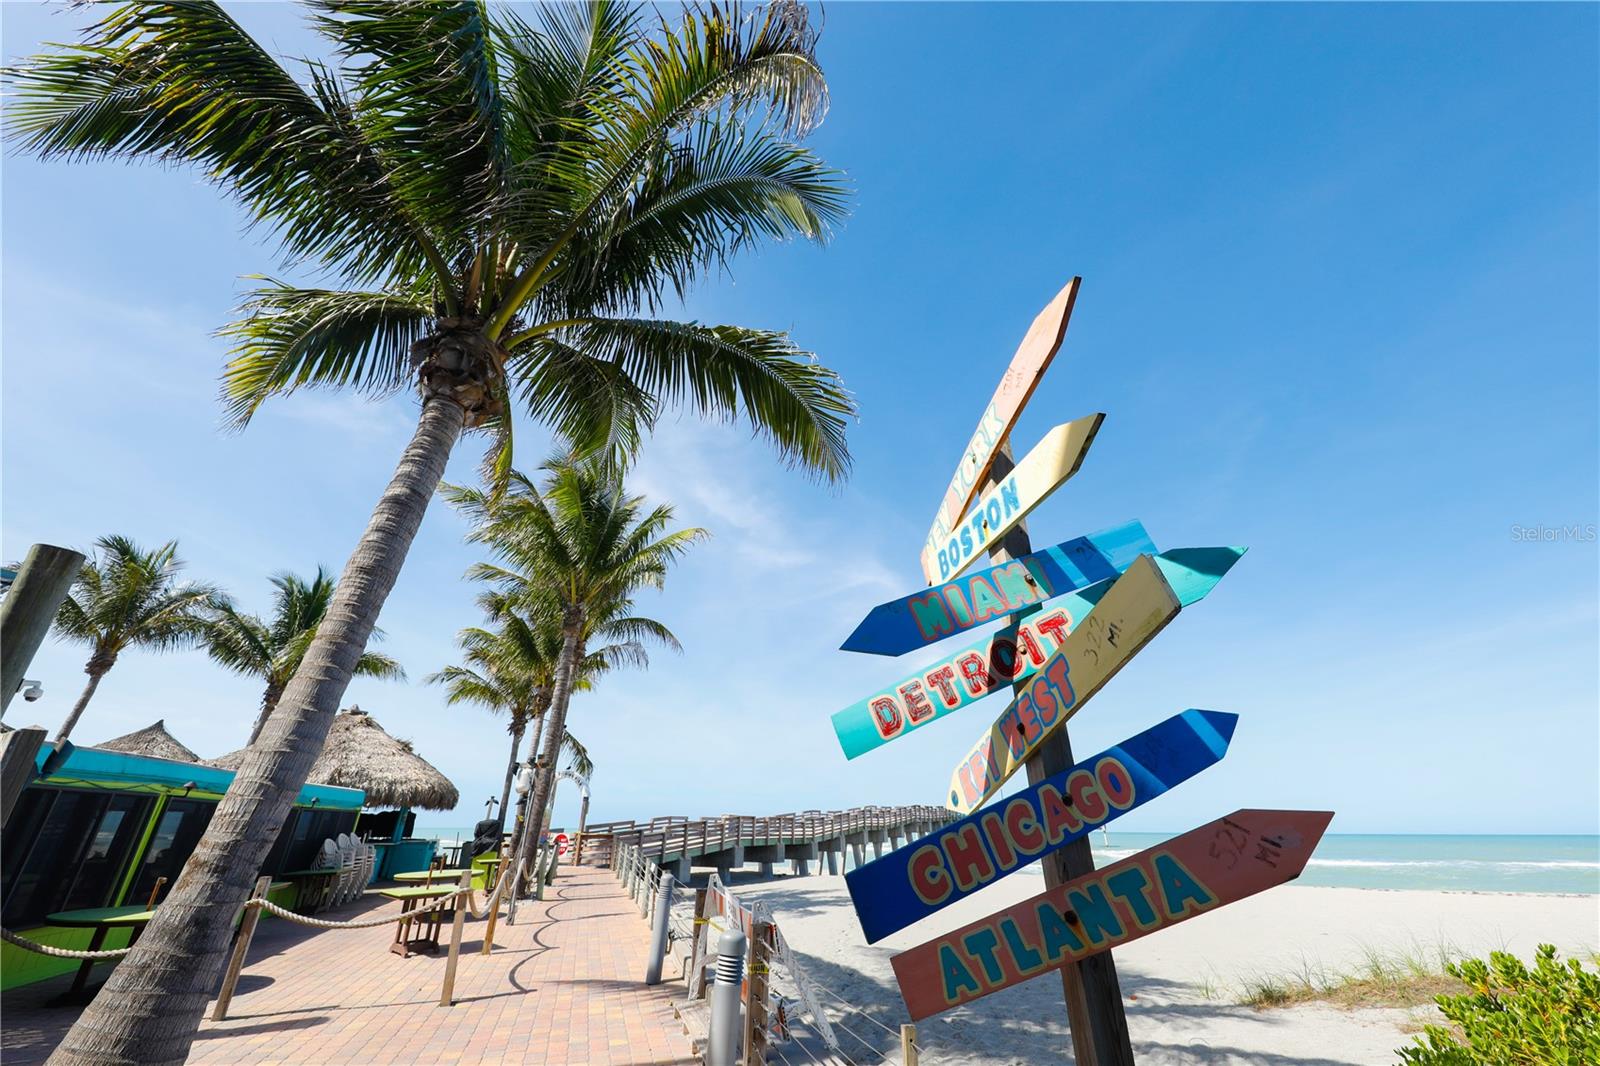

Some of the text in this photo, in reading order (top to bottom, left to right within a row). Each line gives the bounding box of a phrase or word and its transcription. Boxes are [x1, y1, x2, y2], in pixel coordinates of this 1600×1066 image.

[952, 402, 1004, 502] YORK
[937, 477, 1021, 580] BOSTON
[909, 558, 1055, 641] MIAMI
[867, 608, 1073, 740] DETROIT
[958, 653, 1077, 809] KEY WEST
[907, 757, 1136, 905] CHICAGO
[936, 851, 1219, 1006] ATLANTA
